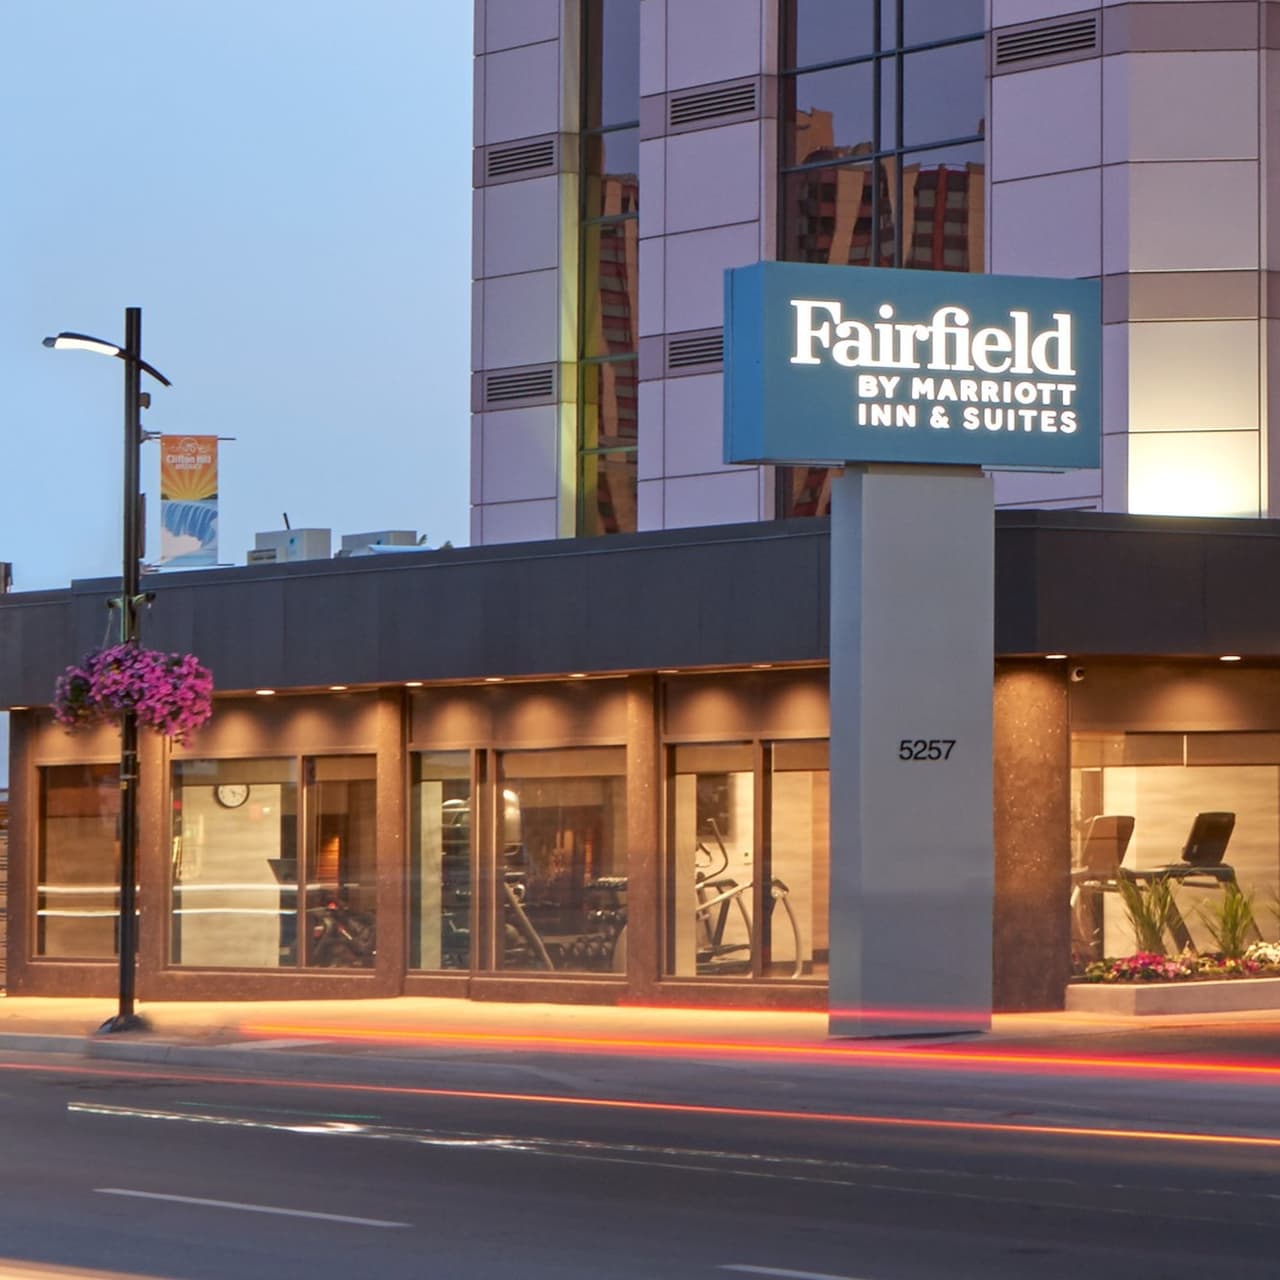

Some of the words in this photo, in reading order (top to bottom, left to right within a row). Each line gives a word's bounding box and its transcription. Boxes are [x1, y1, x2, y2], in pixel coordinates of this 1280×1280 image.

[789, 298, 1077, 377] Fairfield
[857, 374, 900, 399] BY
[911, 376, 1077, 406] MARRIOTT
[857, 403, 917, 428] INN
[929, 406, 950, 430] &
[963, 407, 1078, 434] SUITES
[899, 739, 957, 761] 5257
